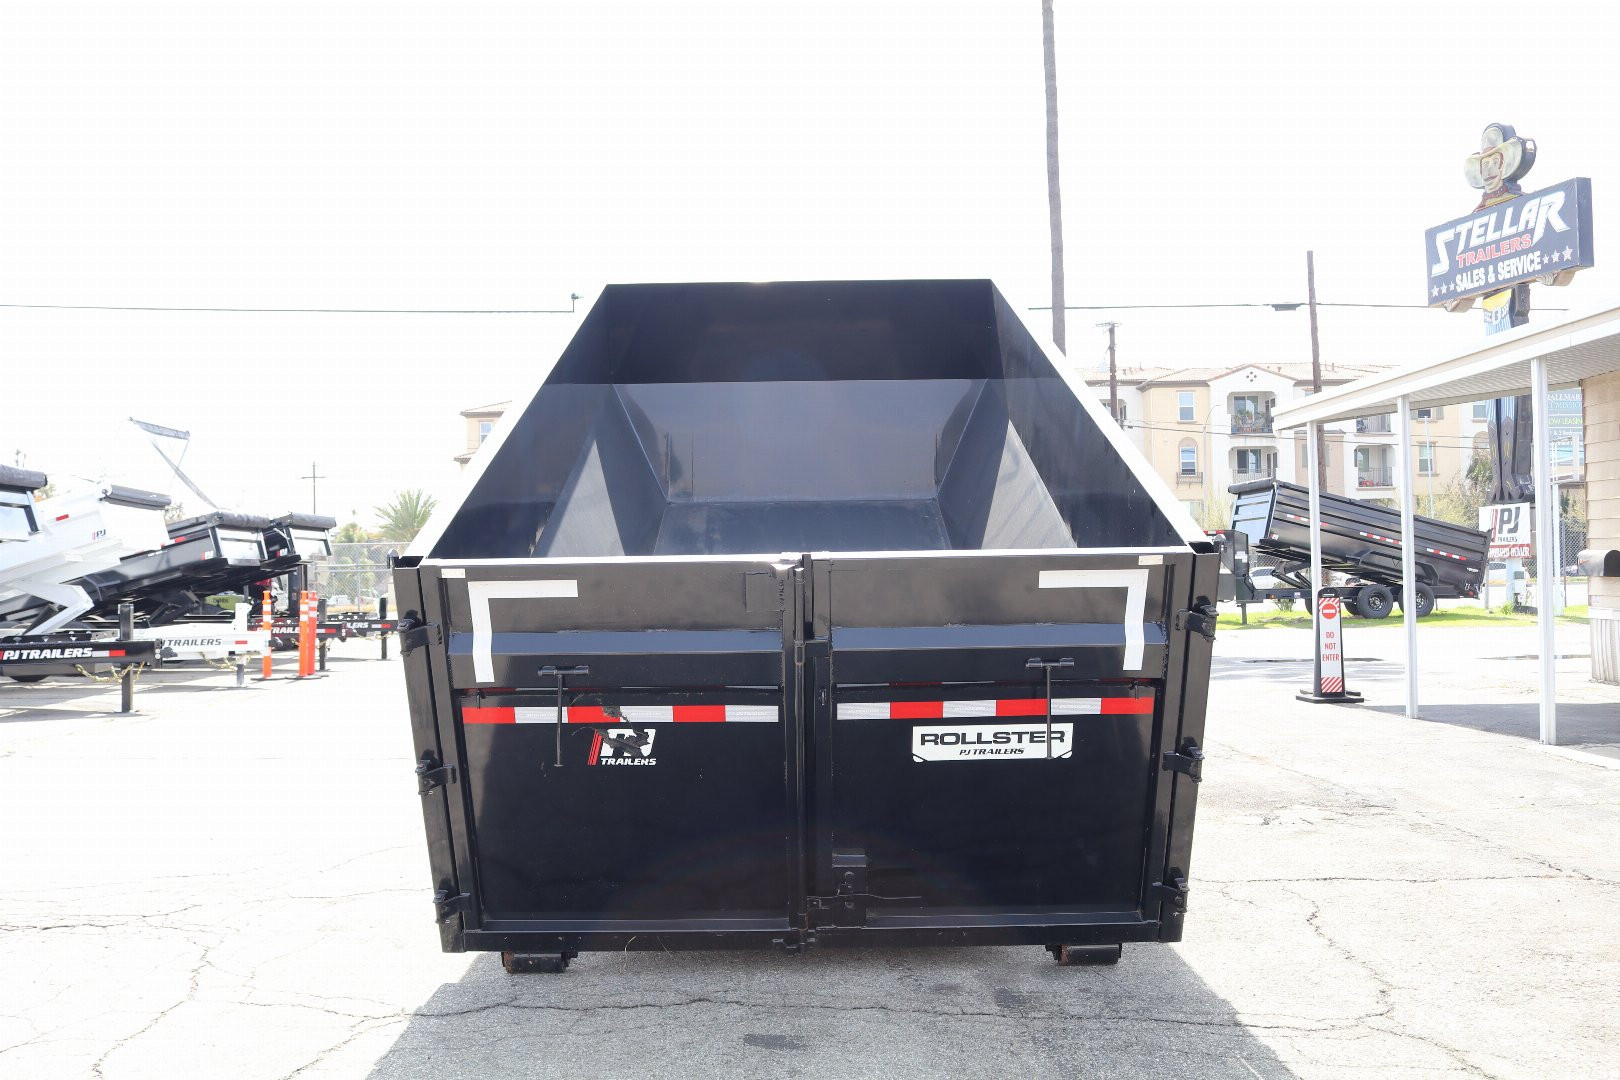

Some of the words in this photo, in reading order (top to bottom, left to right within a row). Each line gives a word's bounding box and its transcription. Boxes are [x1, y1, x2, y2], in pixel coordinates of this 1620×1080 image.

[1431, 191, 1571, 278] STELLAR
[1456, 233, 1532, 269] TRAILERS
[1455, 267, 1485, 292] SALES
[1487, 264, 1496, 284] &
[1497, 251, 1541, 280] SERVICE
[1498, 506, 1521, 534] PJ
[168, 638, 222, 647] TRAILERS
[1324, 642, 1337, 650] NOT
[21, 647, 93, 660] TRAILERS
[1322, 653, 1340, 662] ENTER
[920, 730, 1066, 746] ROLLSTER
[972, 747, 1025, 755] TRAILERS
[600, 757, 657, 766] TRAILERS
